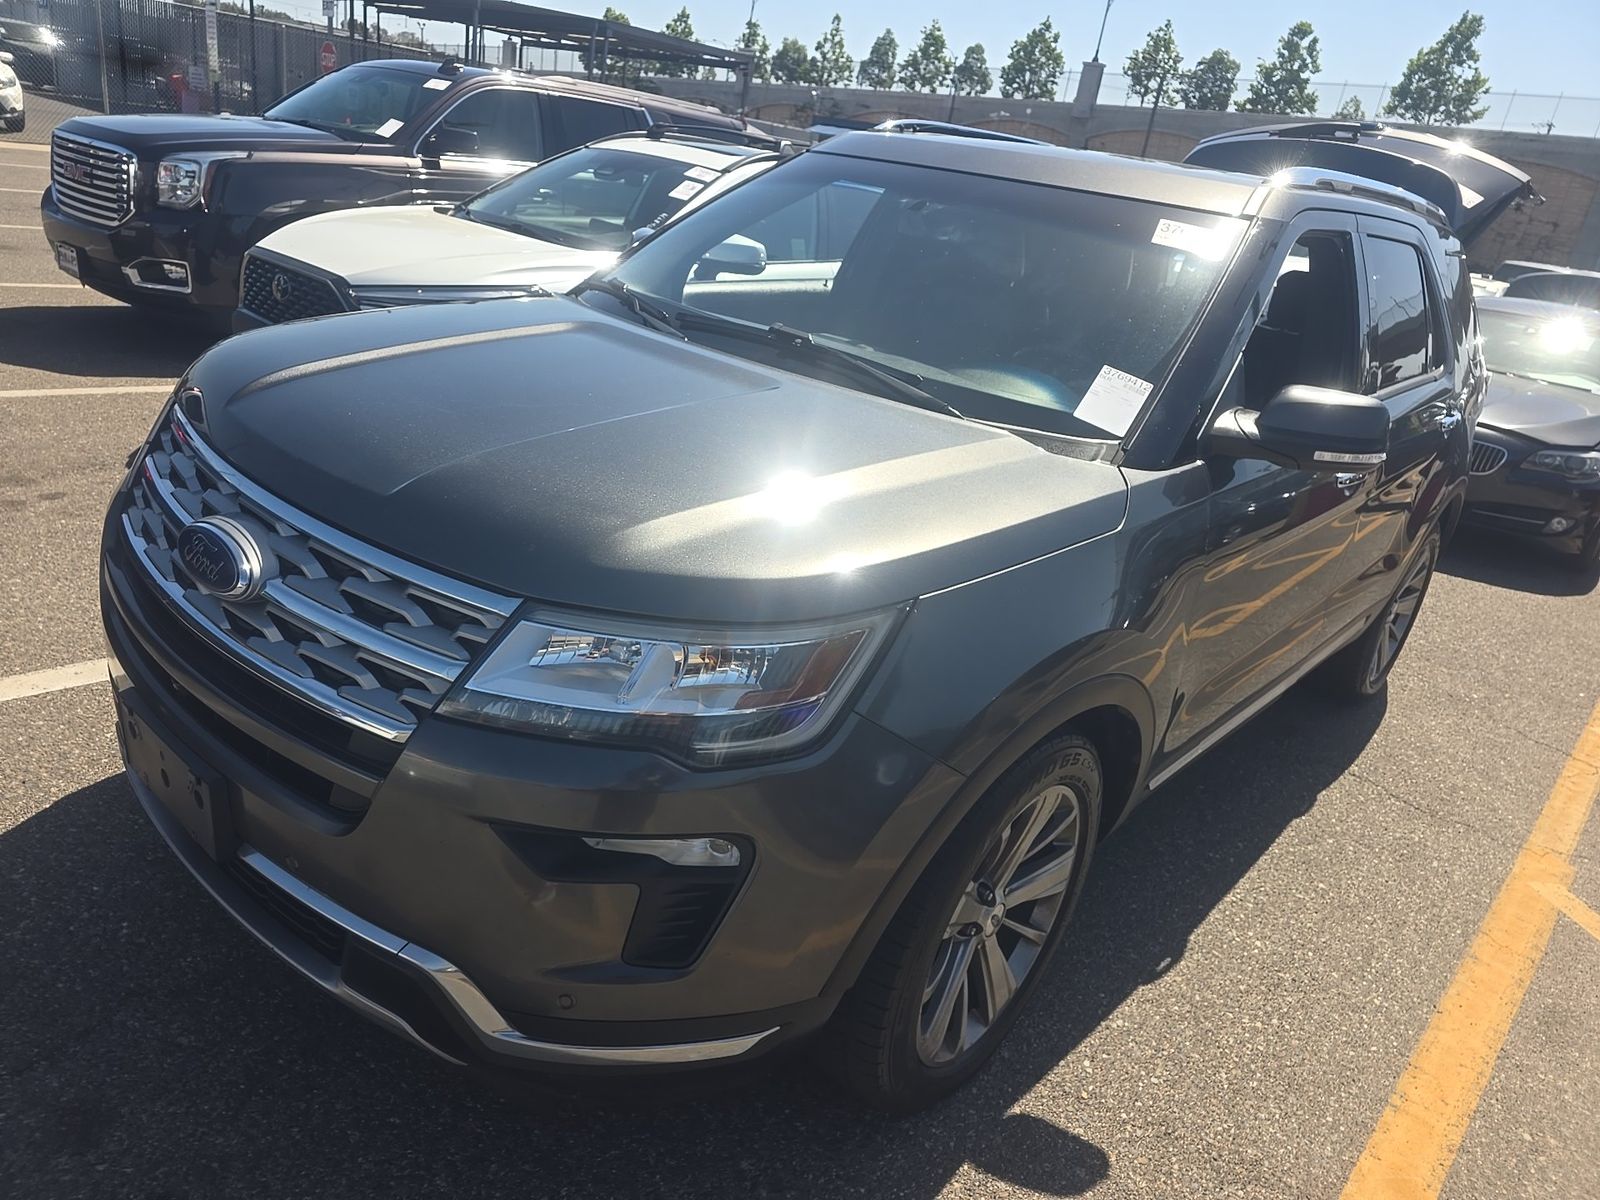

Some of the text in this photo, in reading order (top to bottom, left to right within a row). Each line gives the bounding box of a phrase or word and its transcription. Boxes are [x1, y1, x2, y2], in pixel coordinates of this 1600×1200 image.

[64, 162, 91, 184] GMC
[1103, 367, 1152, 392] 3769412
[184, 533, 225, 581] Ford
